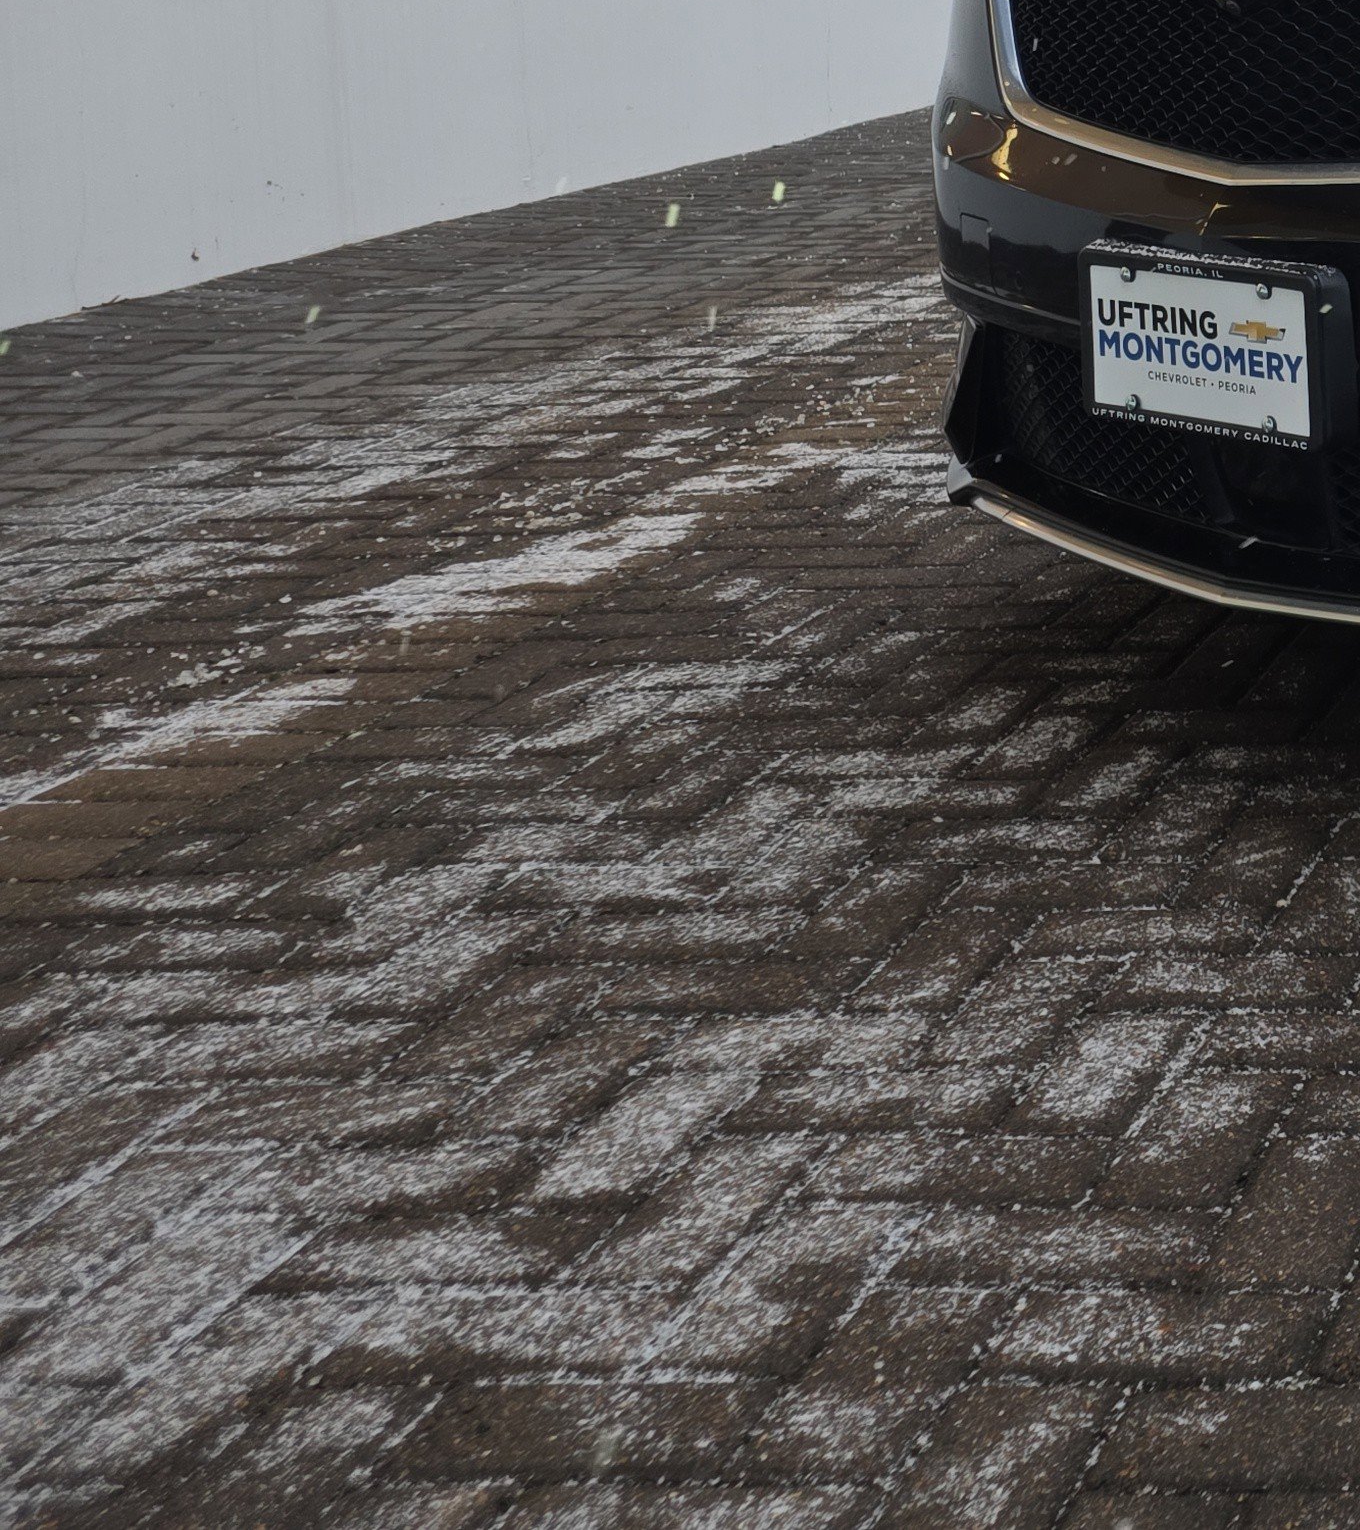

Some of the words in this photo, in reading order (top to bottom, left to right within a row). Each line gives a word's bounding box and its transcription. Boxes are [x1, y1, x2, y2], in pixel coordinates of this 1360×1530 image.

[1211, 269, 1224, 279] IL
[1097, 297, 1218, 340] UFTRING
[1098, 329, 1304, 384] MONTGOMERY
[1147, 370, 1208, 388] CHEVROLET
[1218, 380, 1257, 395] PEORIA
[1091, 407, 1146, 423] UFTRING
[1150, 416, 1239, 438] MONTGOMERY
[1243, 432, 1309, 451] CADILLAC
